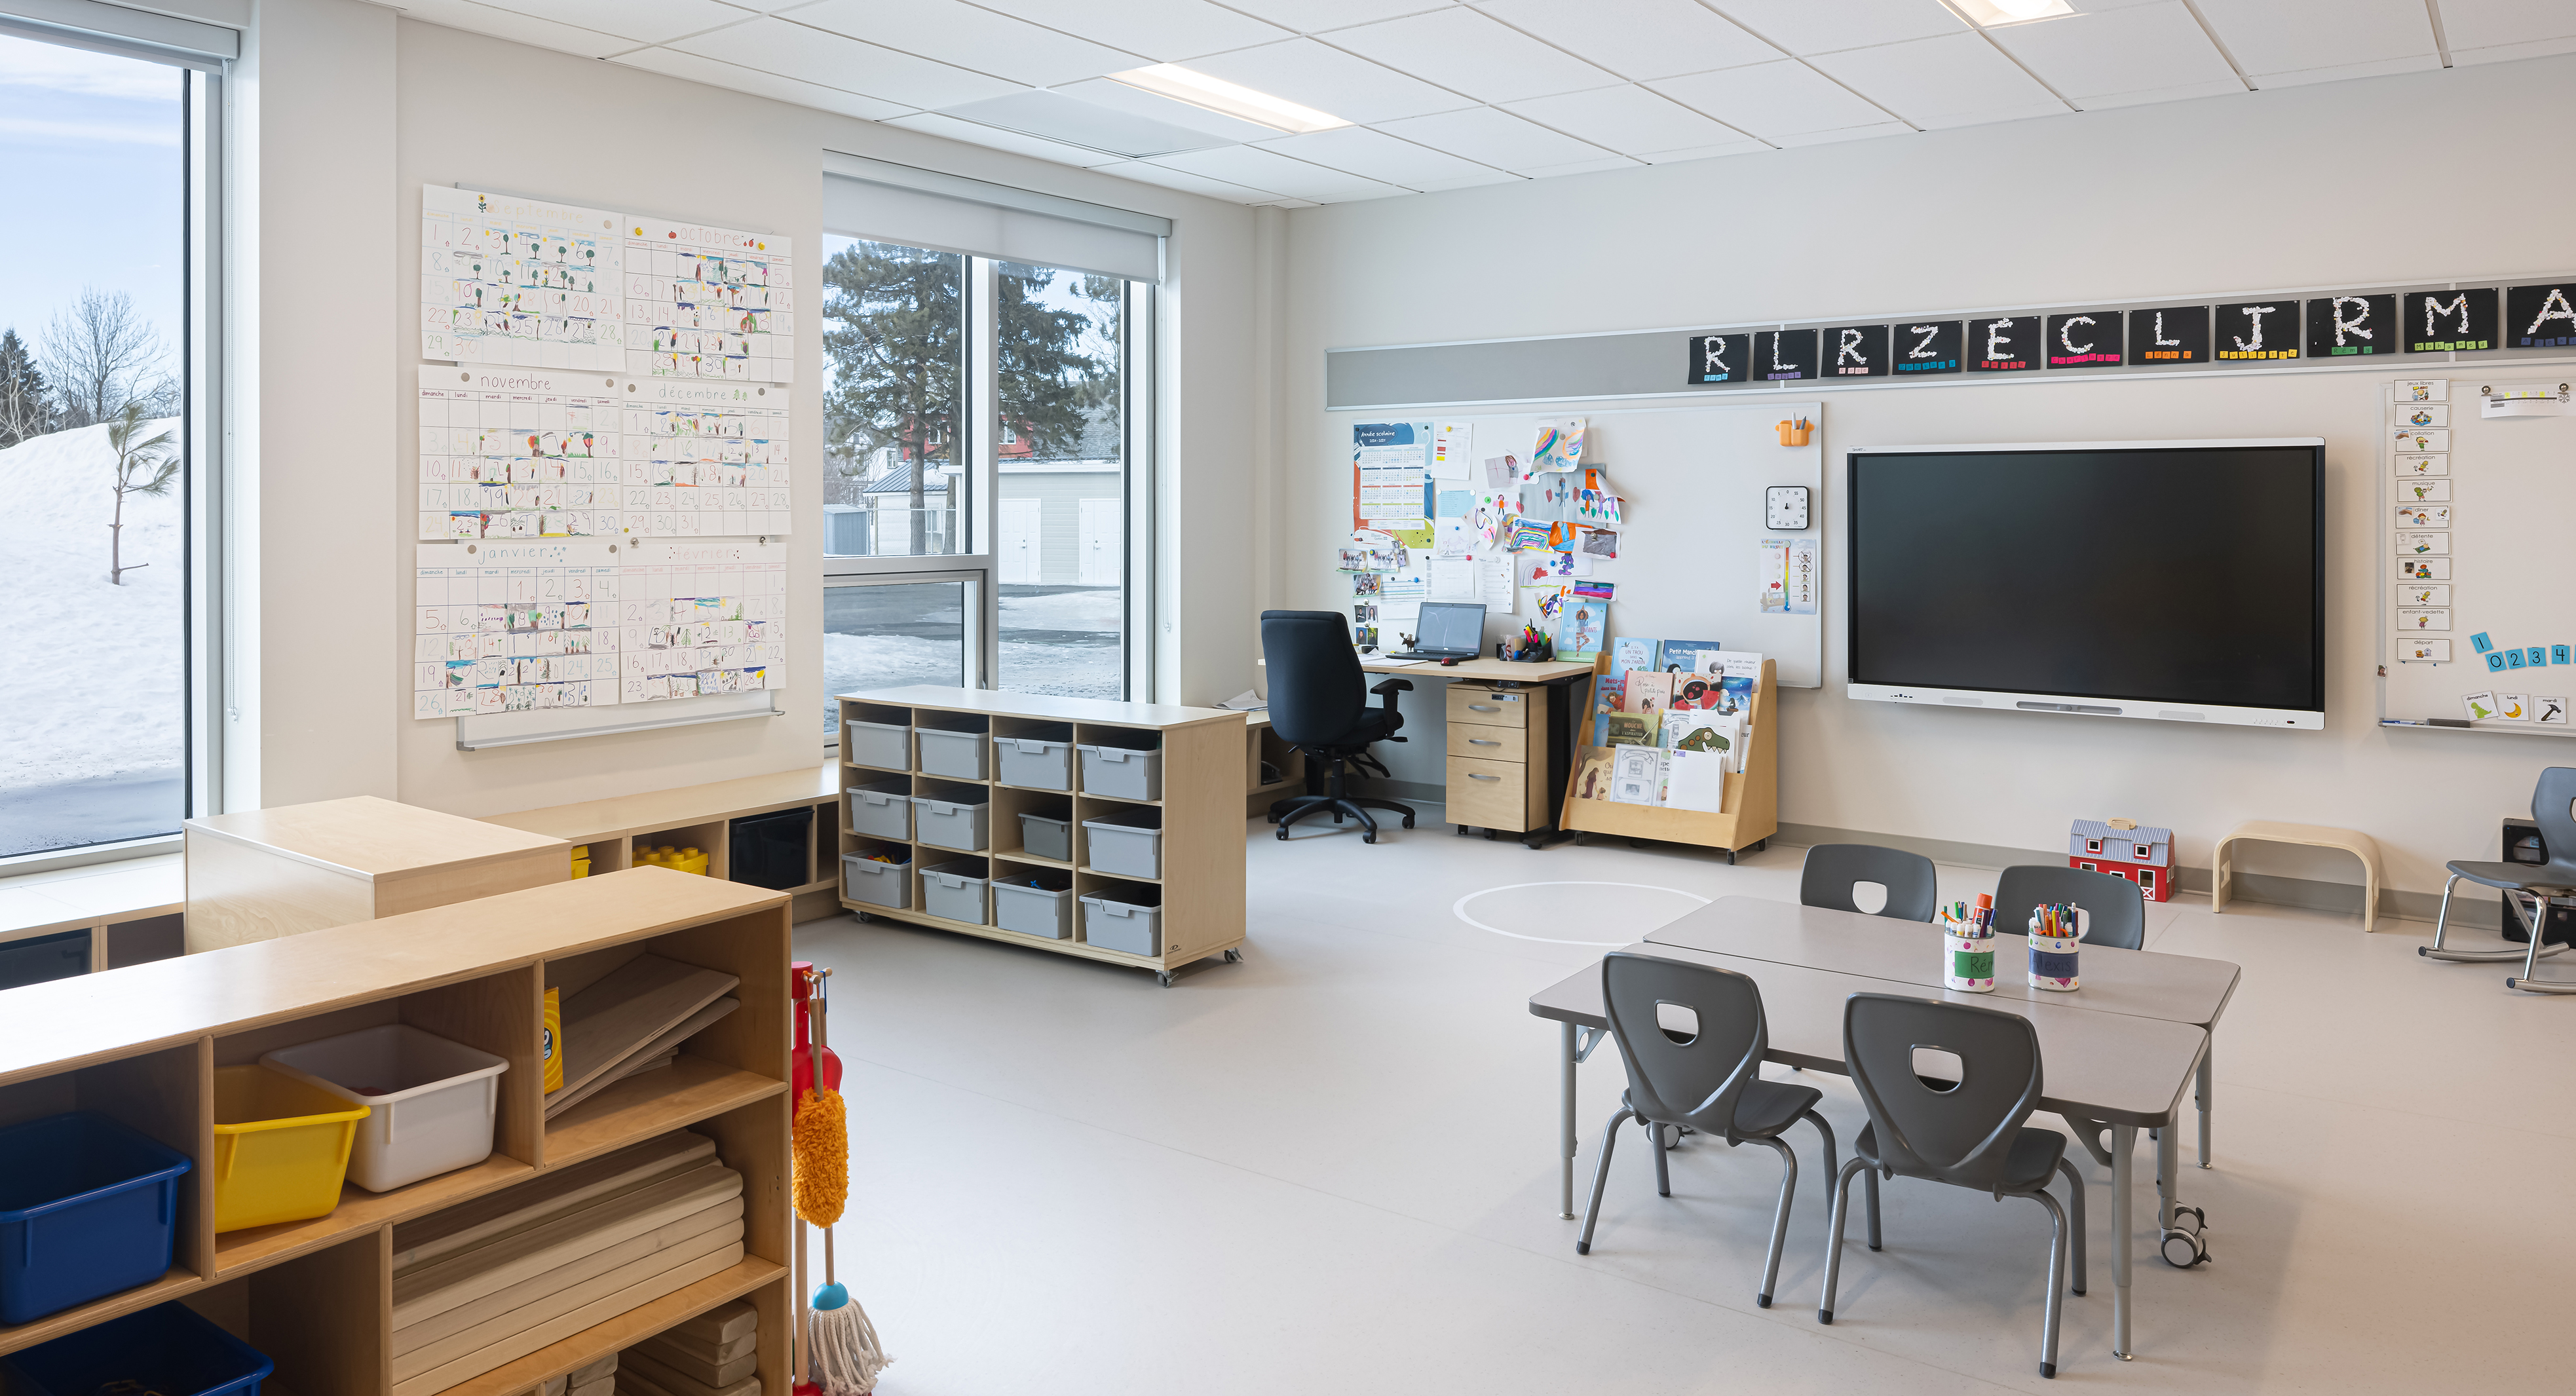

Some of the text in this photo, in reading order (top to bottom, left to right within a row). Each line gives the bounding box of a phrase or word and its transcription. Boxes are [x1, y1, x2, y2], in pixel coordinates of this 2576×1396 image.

[461, 227, 613, 261] 2 3 4 6 7
[680, 227, 742, 246] octobre
[432, 252, 442, 271] 8
[774, 268, 784, 284] 5
[633, 276, 785, 305] 6 7 12
[573, 295, 613, 314] 20 21
[632, 304, 716, 322] 13 14 16
[428, 307, 616, 340] 22 28
[1704, 289, 2576, 372] R L R Z C L J R M A
[427, 335, 443, 350] 29
[2222, 349, 2296, 359] Juliette
[2416, 341, 2488, 350] Mohamed
[481, 373, 551, 390] novembre
[658, 383, 727, 400] décembre
[600, 436, 608, 453] 9
[426, 459, 611, 479] 10 11 15 16
[426, 488, 561, 508] 17 18 19 21
[630, 490, 786, 506] 22 23 24 25 27 28
[599, 516, 616, 530] 30
[630, 514, 692, 530] 29 30 31
[478, 546, 547, 565] janvier
[517, 578, 609, 600] 1 2 3 4
[426, 609, 469, 629] 5 6
[2478, 637, 2484, 649] 1
[627, 651, 687, 670] 16 17 18
[2490, 649, 2565, 668] 0 2 3 4
[628, 681, 642, 692] 23
[1635, 676, 1650, 694] Rose
[1644, 688, 1665, 697] petits pois
[2032, 953, 2071, 972] Alexis
